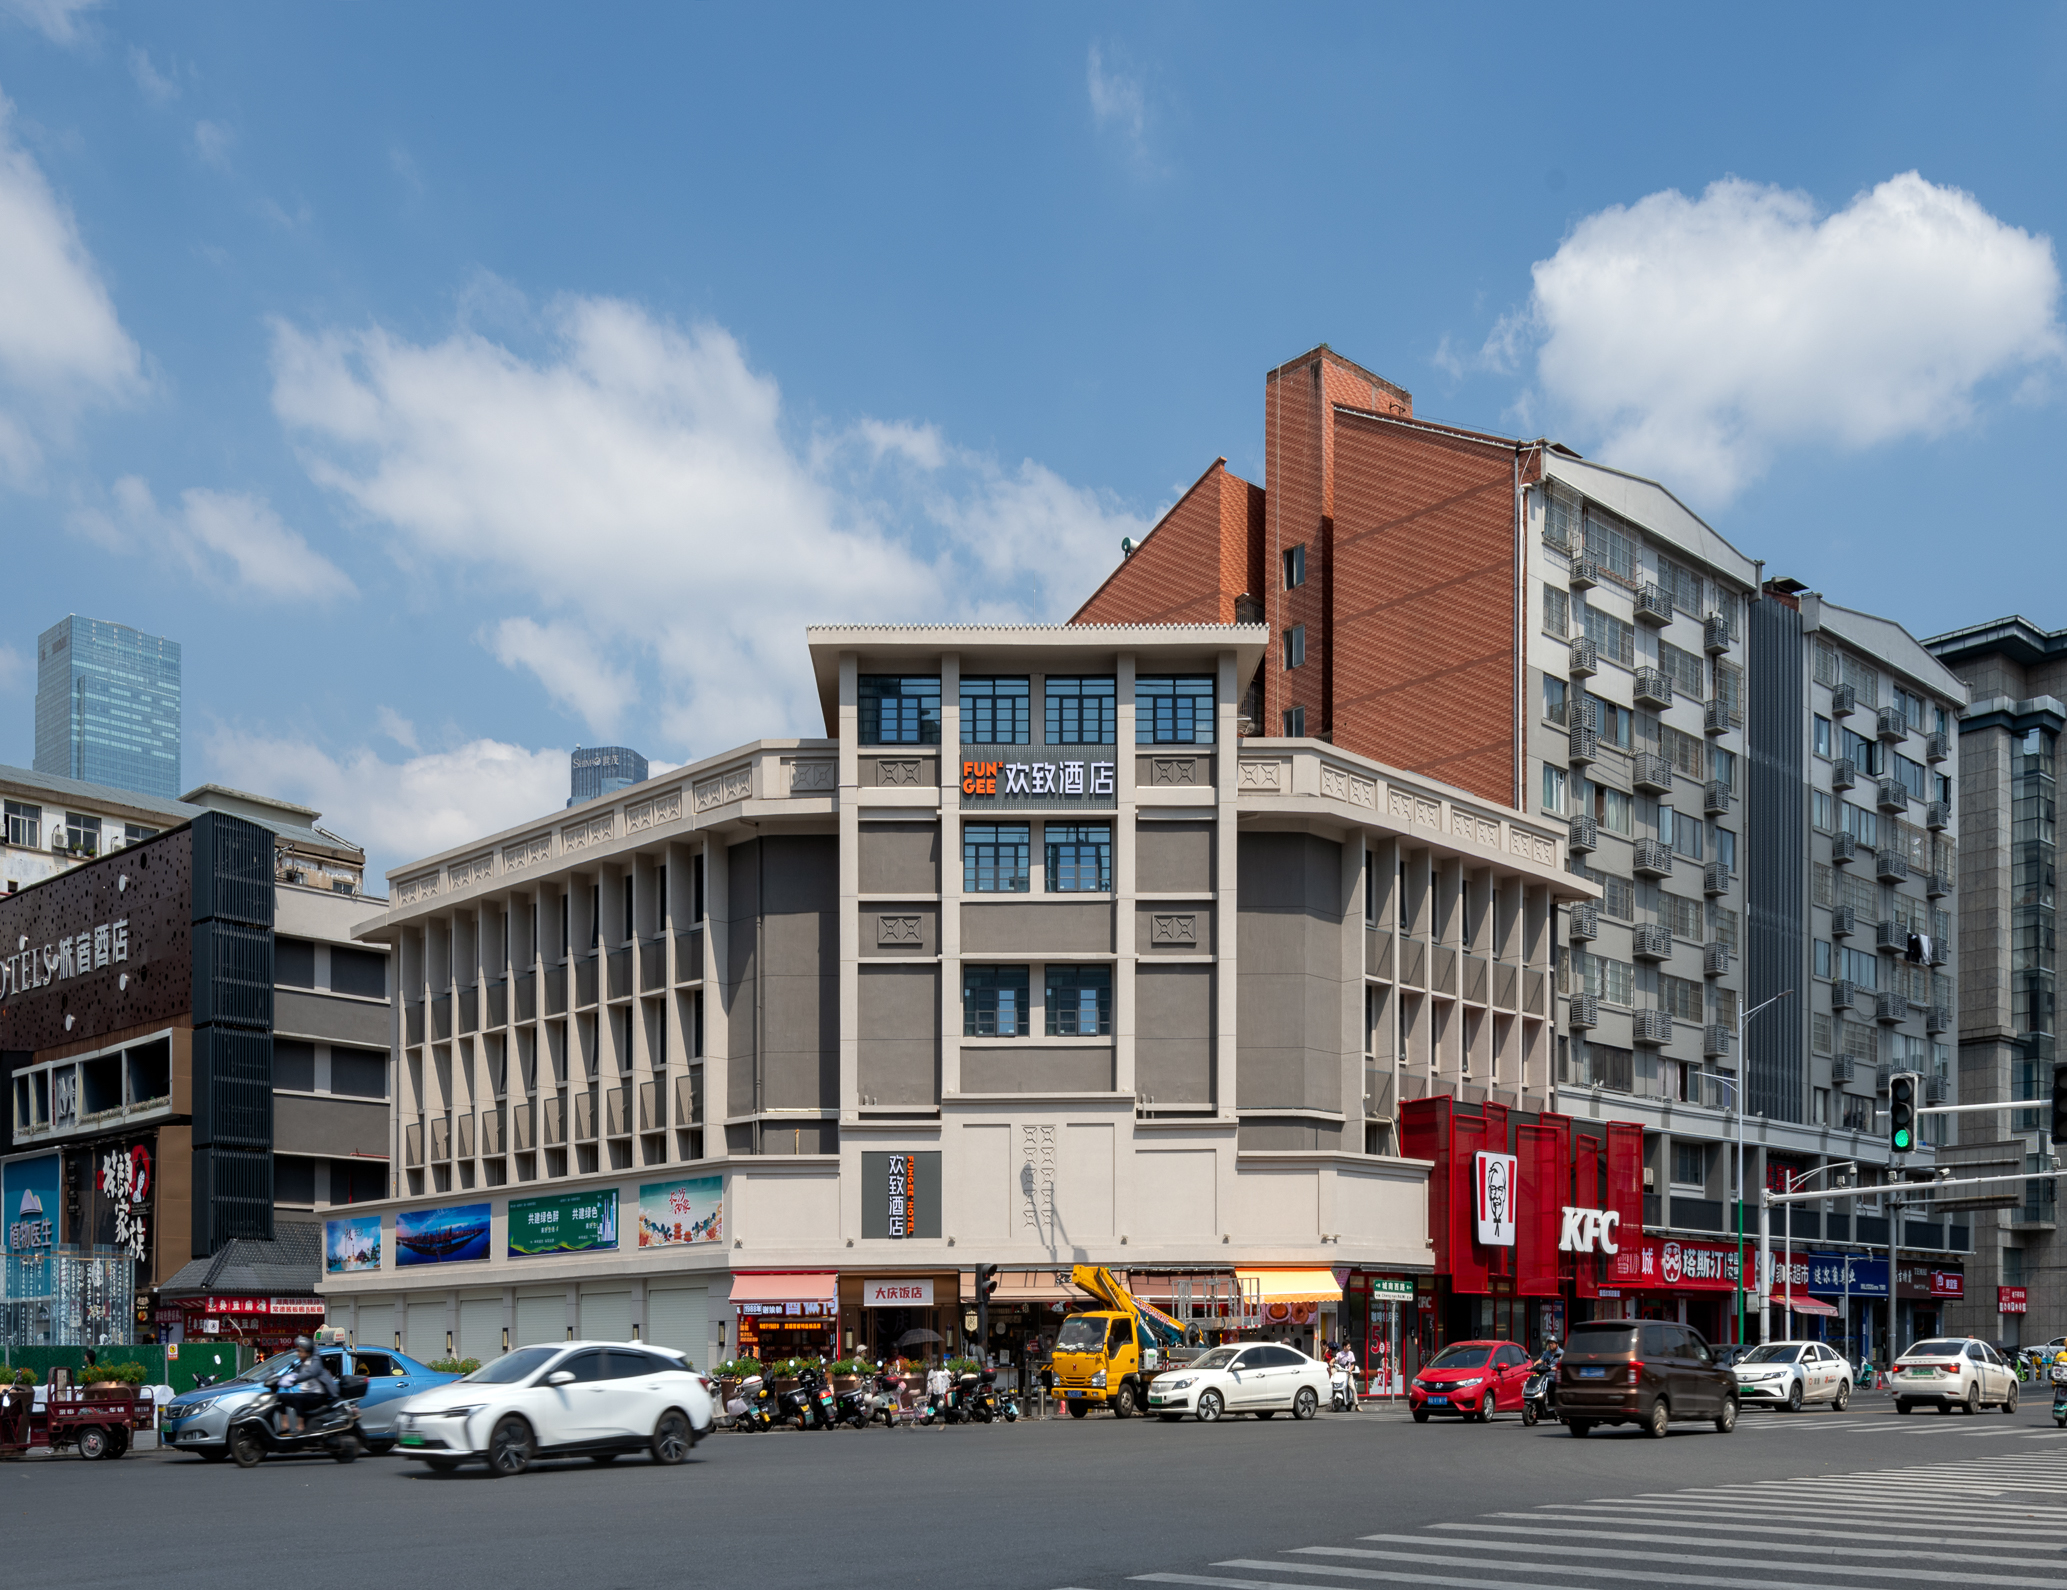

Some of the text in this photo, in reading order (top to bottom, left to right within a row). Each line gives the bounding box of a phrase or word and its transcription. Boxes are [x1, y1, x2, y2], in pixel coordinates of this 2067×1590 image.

[962, 778, 996, 794] GEE
[1005, 760, 1114, 794] 欢致酒店
[59, 918, 129, 981] 城宿酒店
[888, 1154, 904, 1236] 欢致酒店
[9, 1217, 52, 1250] 植物医生
[1558, 1206, 1620, 1254] KFC
[1682, 1248, 1725, 1280] 塔斯汀
[875, 1286, 923, 1299] 大庆饭店
[1381, 1281, 1406, 1292] 城南西路
[219, 1299, 254, 1312] 臭豆腐
[1370, 1324, 1381, 1355] 5
